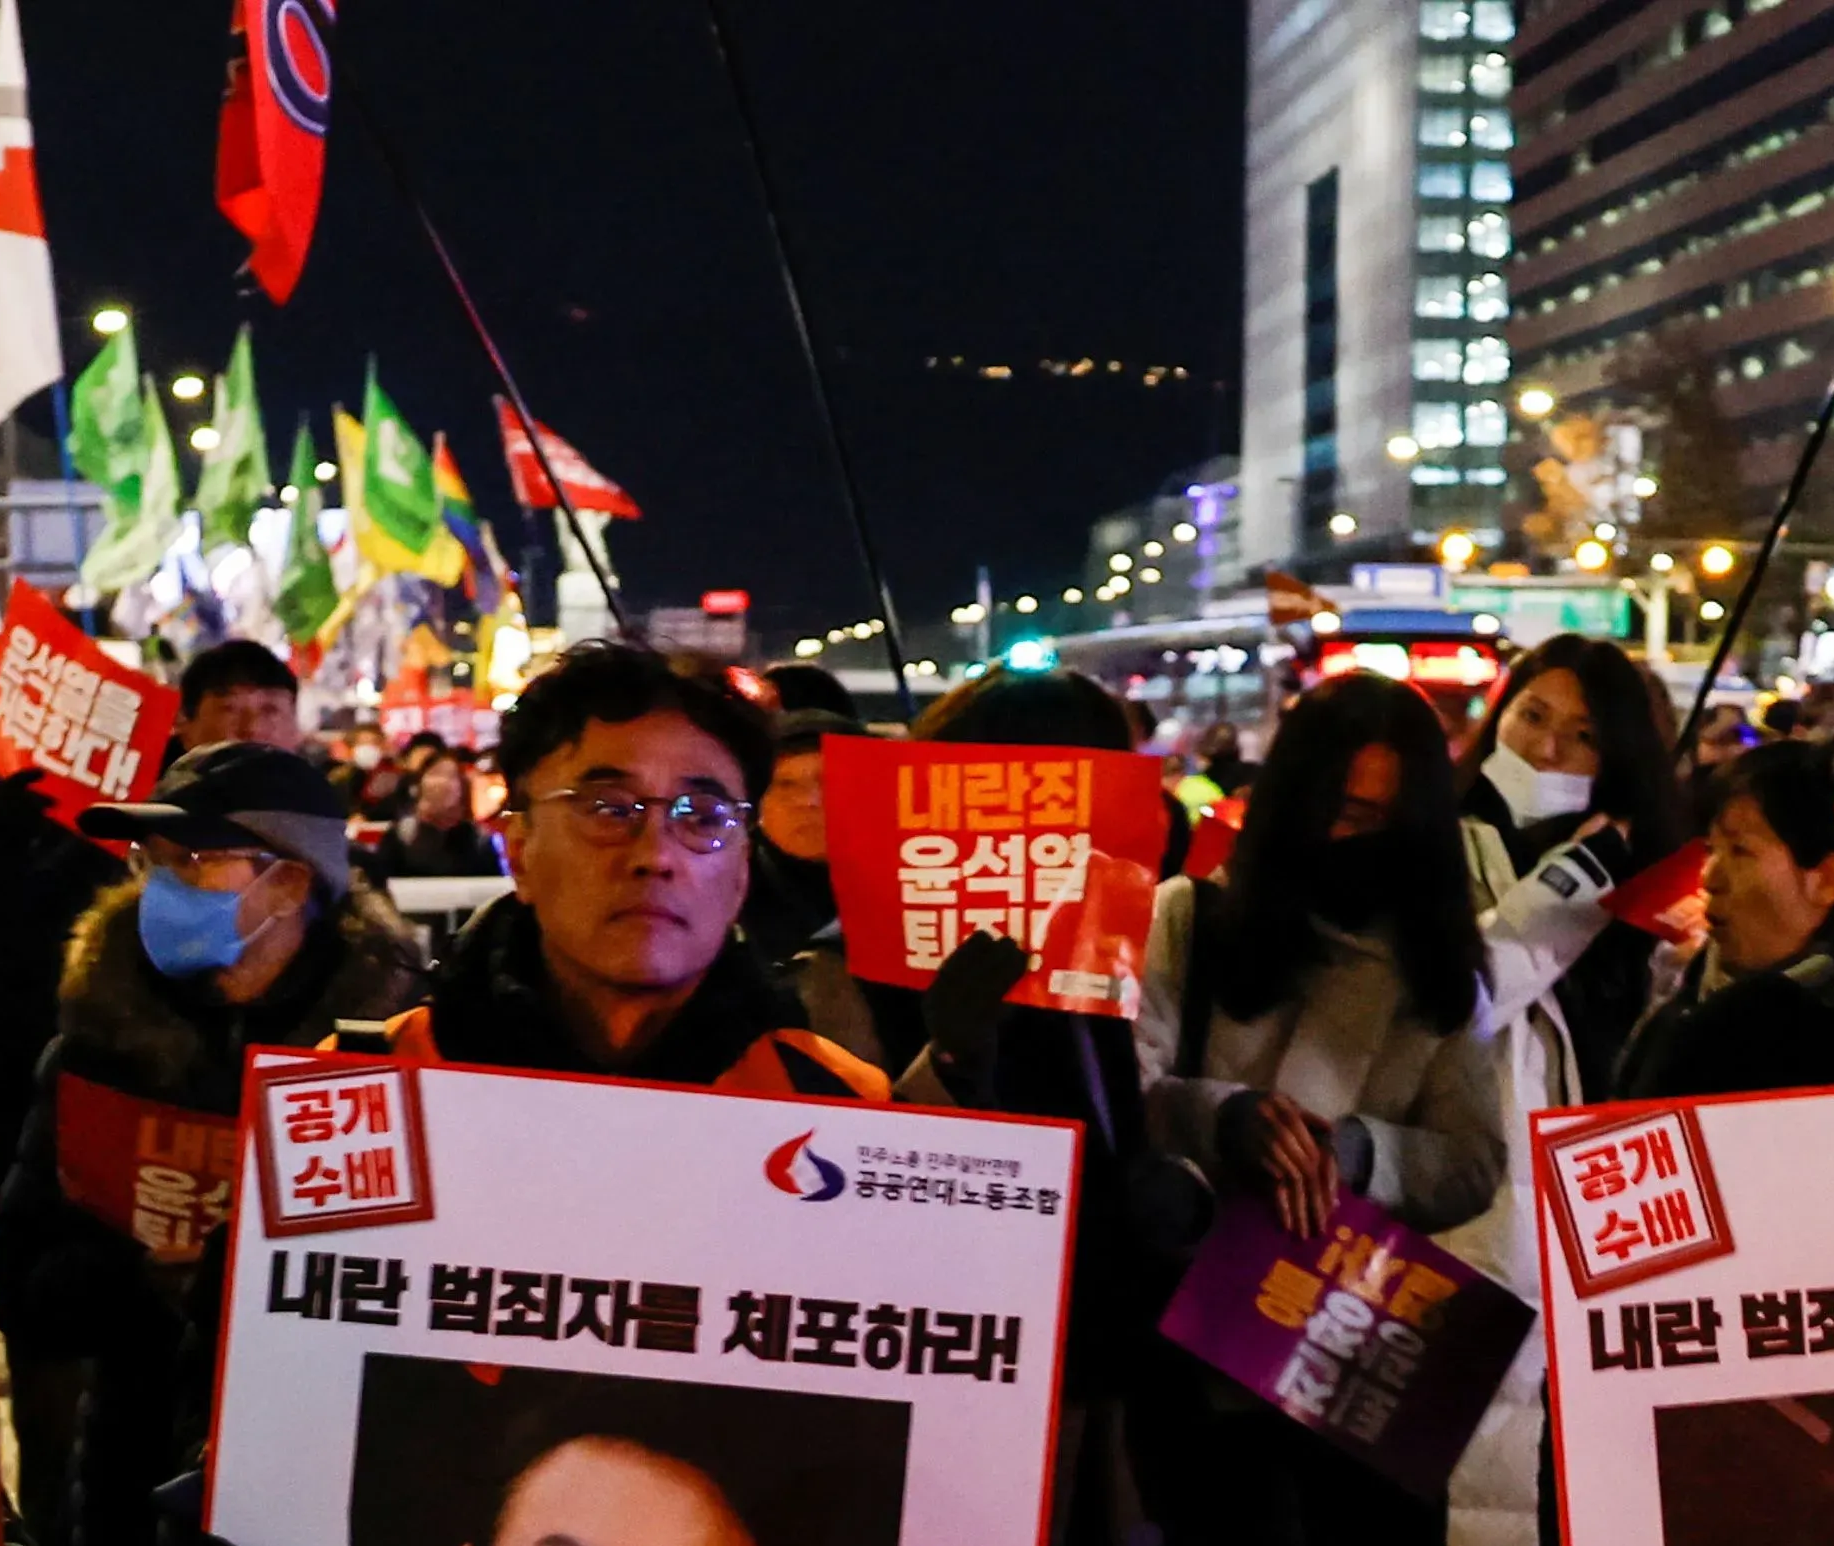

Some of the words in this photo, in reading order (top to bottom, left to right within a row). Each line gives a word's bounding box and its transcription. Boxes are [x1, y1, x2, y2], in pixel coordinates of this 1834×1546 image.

[896, 758, 1095, 831] 내란죄
[897, 832, 1093, 905] 윤석열
[283, 1081, 393, 1145] 공개
[292, 1144, 400, 1209] 수배
[854, 1168, 1063, 1220] 공공연대노동조합
[1571, 1125, 1680, 1203] 공개
[1592, 1188, 1699, 1262] 수배
[266, 1250, 409, 1327] 내란
[428, 1263, 702, 1355] 범죄자를
[724, 1289, 1024, 1385] 체포하라!
[1586, 1297, 1723, 1373] 내란
